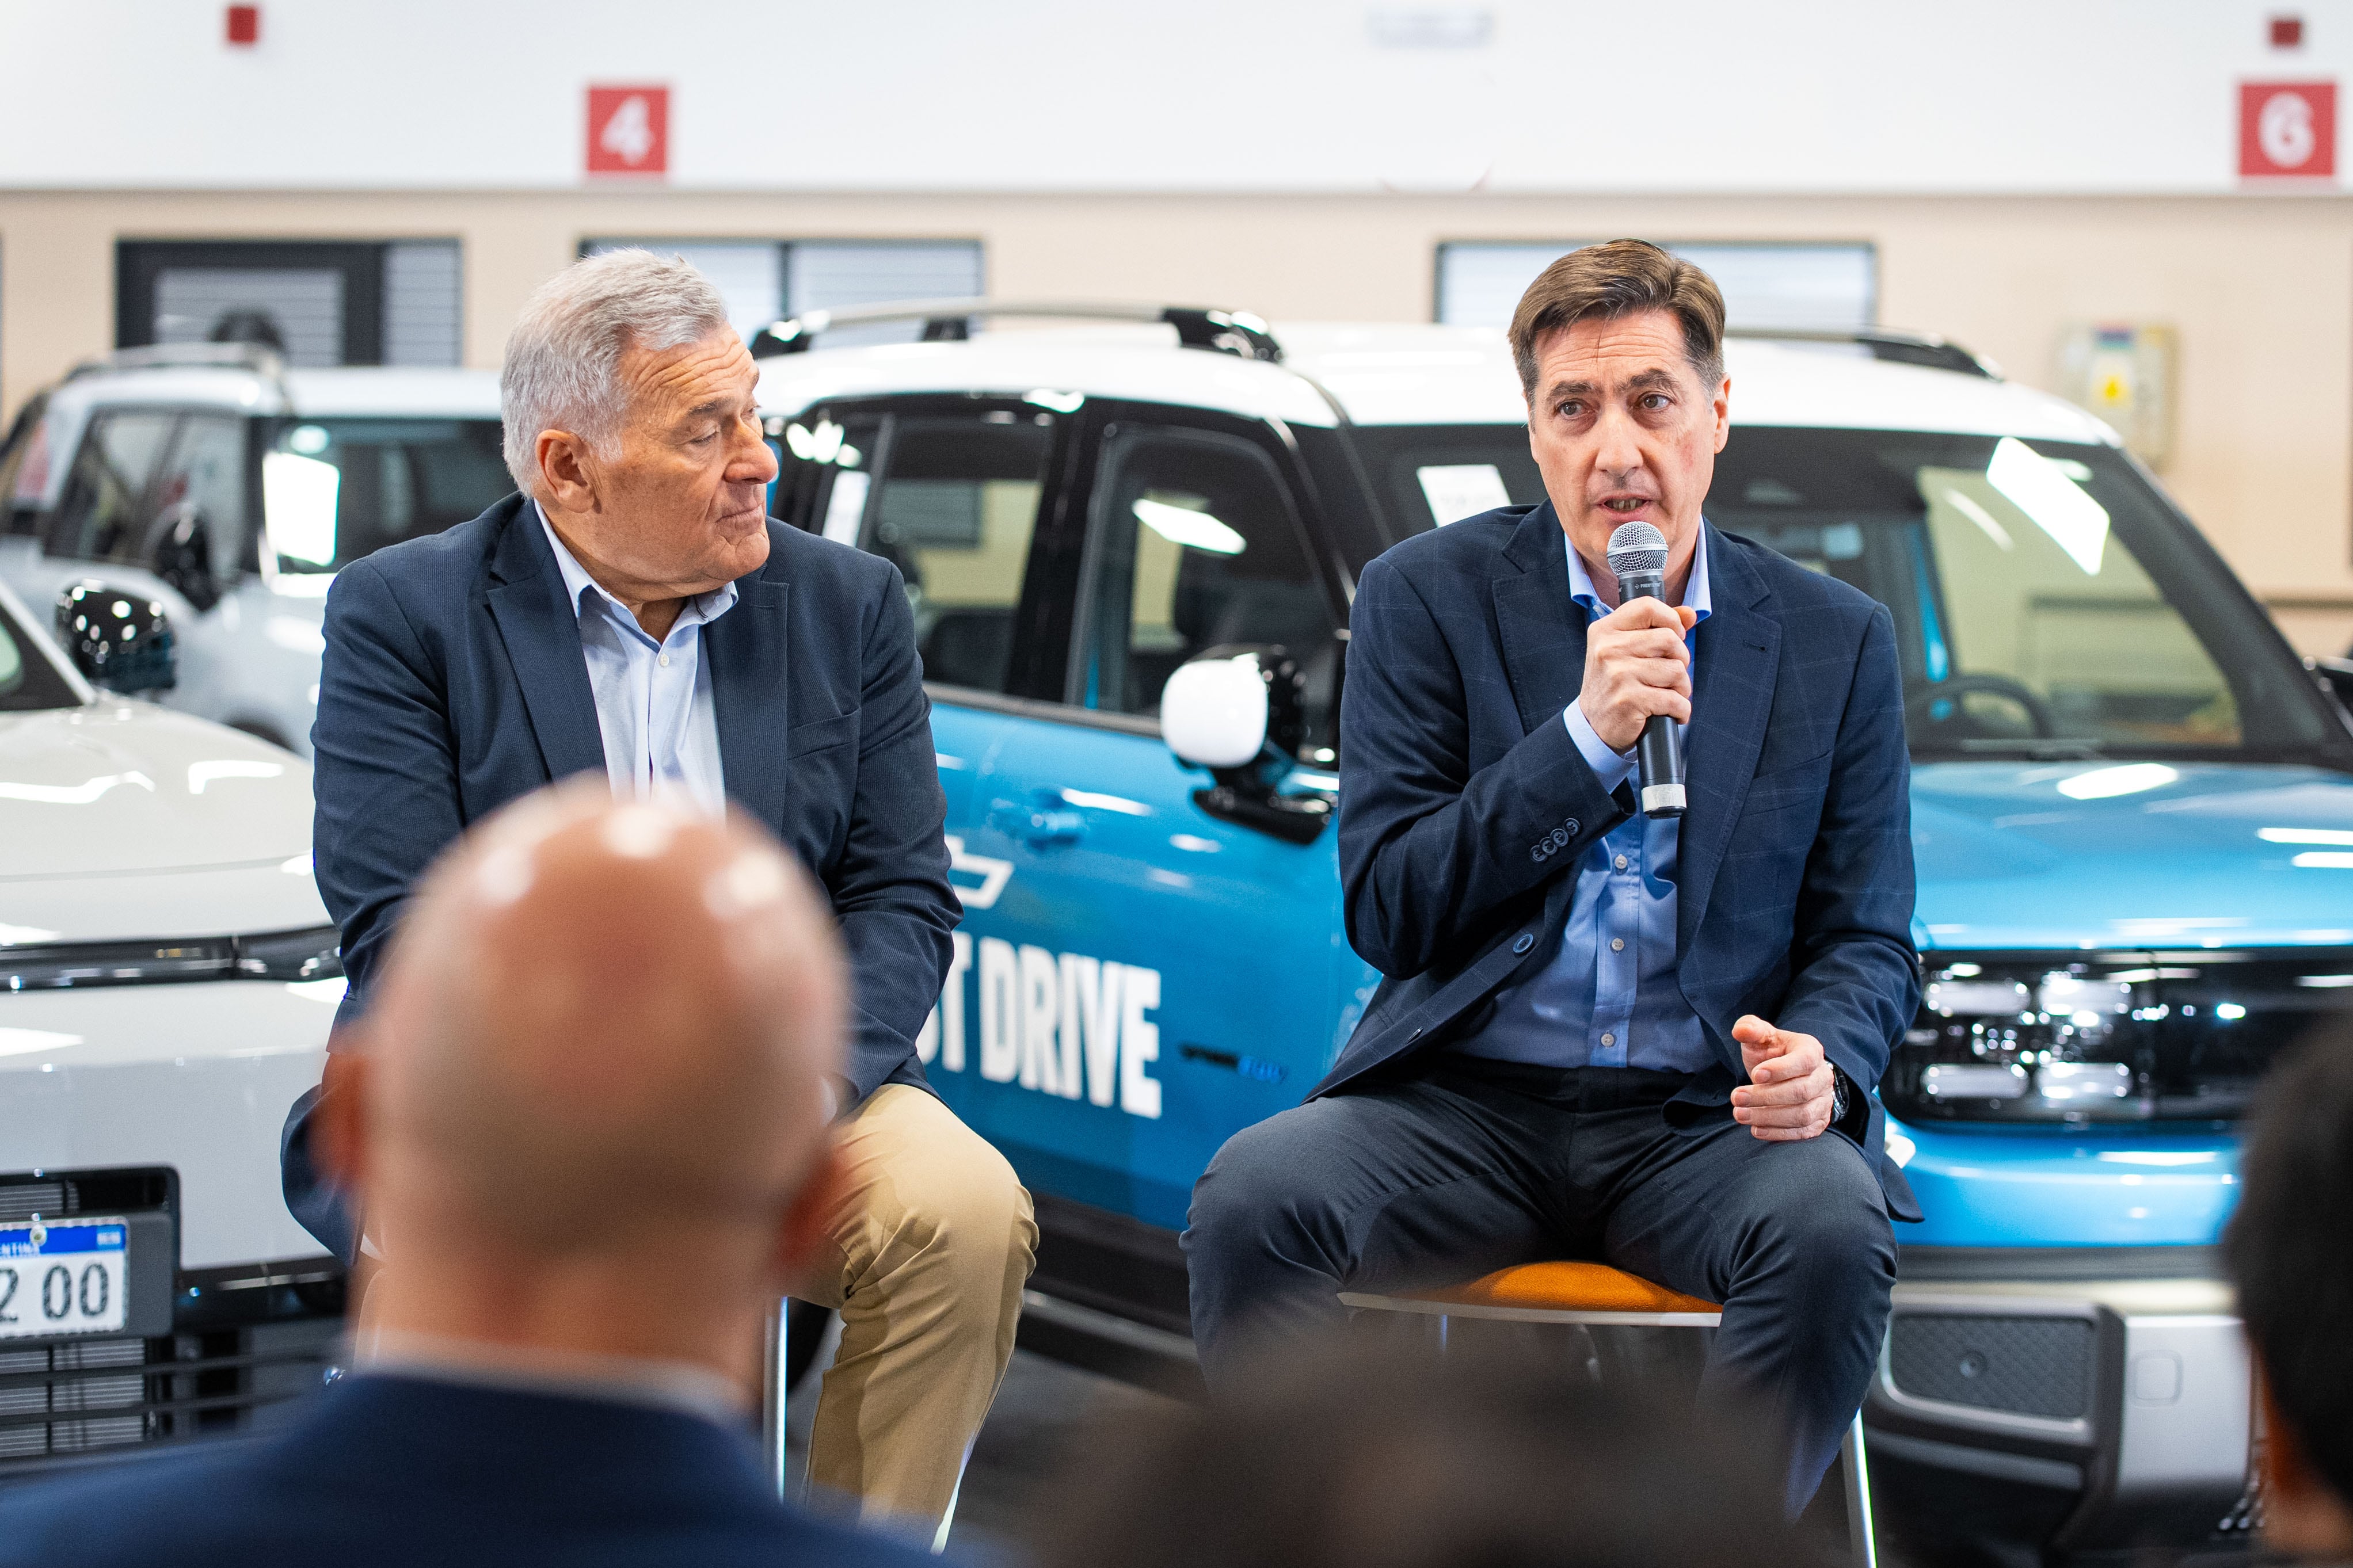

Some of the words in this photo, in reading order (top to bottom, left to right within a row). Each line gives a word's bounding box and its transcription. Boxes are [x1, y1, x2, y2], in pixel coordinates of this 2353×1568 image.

[601, 96, 654, 162] 4
[2259, 92, 2314, 166] 6
[915, 930, 973, 1073] T
[980, 936, 1162, 1119] DRIVE
